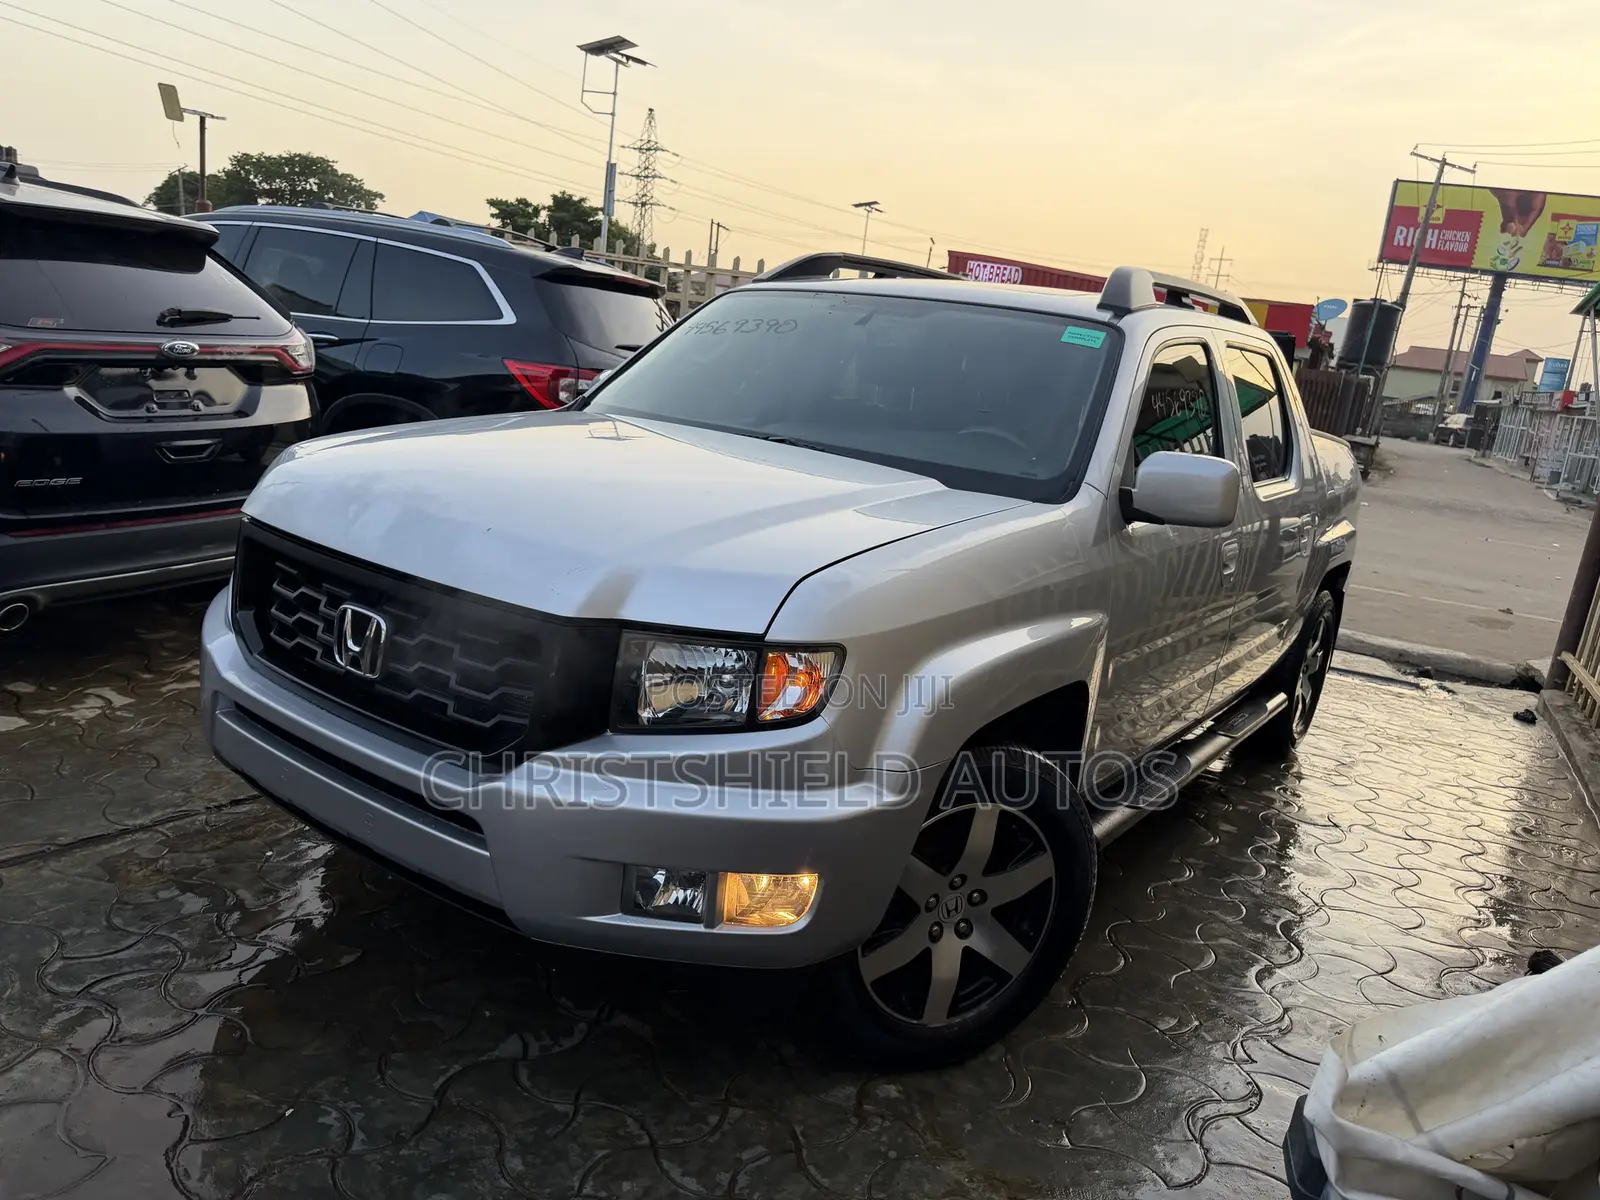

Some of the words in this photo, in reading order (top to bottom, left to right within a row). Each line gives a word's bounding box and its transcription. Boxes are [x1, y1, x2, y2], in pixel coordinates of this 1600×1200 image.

[1440, 229, 1471, 243] CHICKEN
[1437, 240, 1469, 253] FLAVOUR
[173, 343, 192, 354] Ford
[13, 476, 83, 488] EDGE
